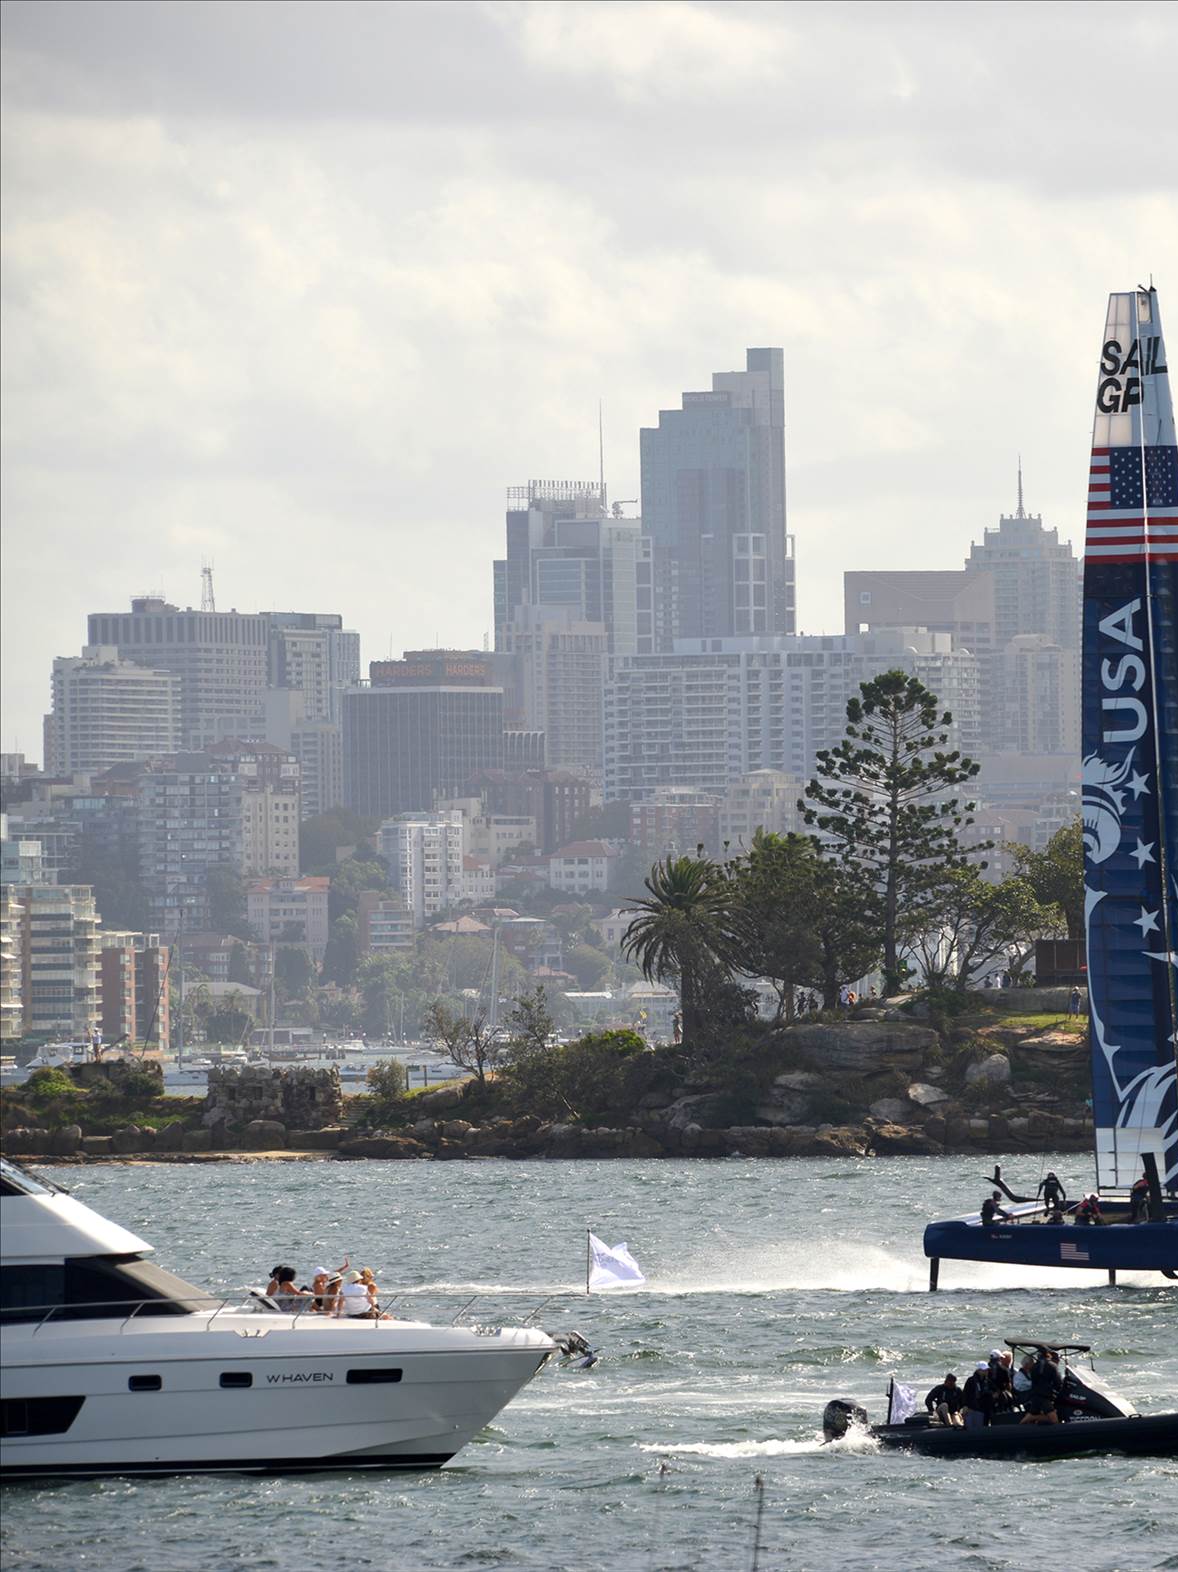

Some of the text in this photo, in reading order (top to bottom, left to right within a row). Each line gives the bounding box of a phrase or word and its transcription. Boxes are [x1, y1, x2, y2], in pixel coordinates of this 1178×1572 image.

[1101, 336, 1168, 376] SAIL
[1097, 377, 1145, 413] GP
[376, 663, 433, 677] HARDERS
[446, 663, 486, 676] HARDERS
[1098, 597, 1149, 743] USA
[282, 1372, 334, 1383] HAVEN
